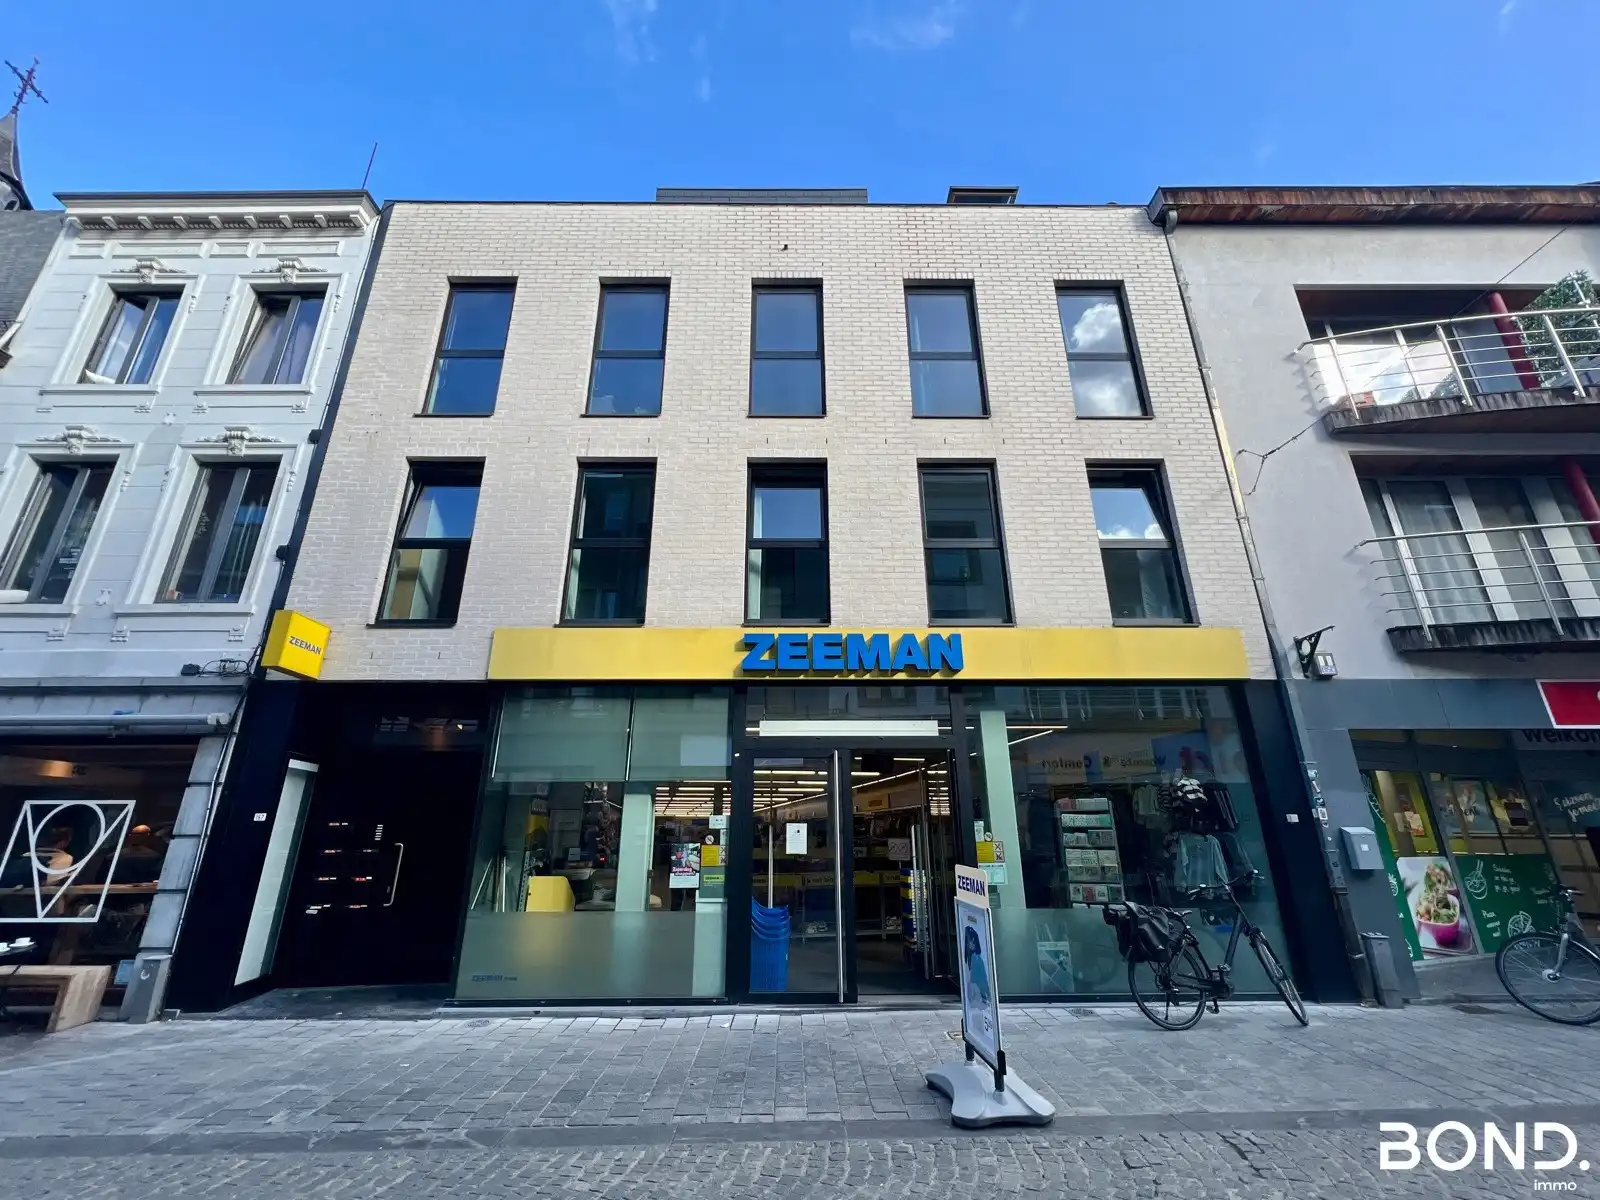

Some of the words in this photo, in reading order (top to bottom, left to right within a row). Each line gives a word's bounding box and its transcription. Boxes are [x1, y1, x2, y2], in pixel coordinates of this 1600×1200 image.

[289, 636, 321, 655] ZEEMAN
[742, 633, 965, 672] ZEEMAN
[957, 875, 986, 897] ZEEMAN
